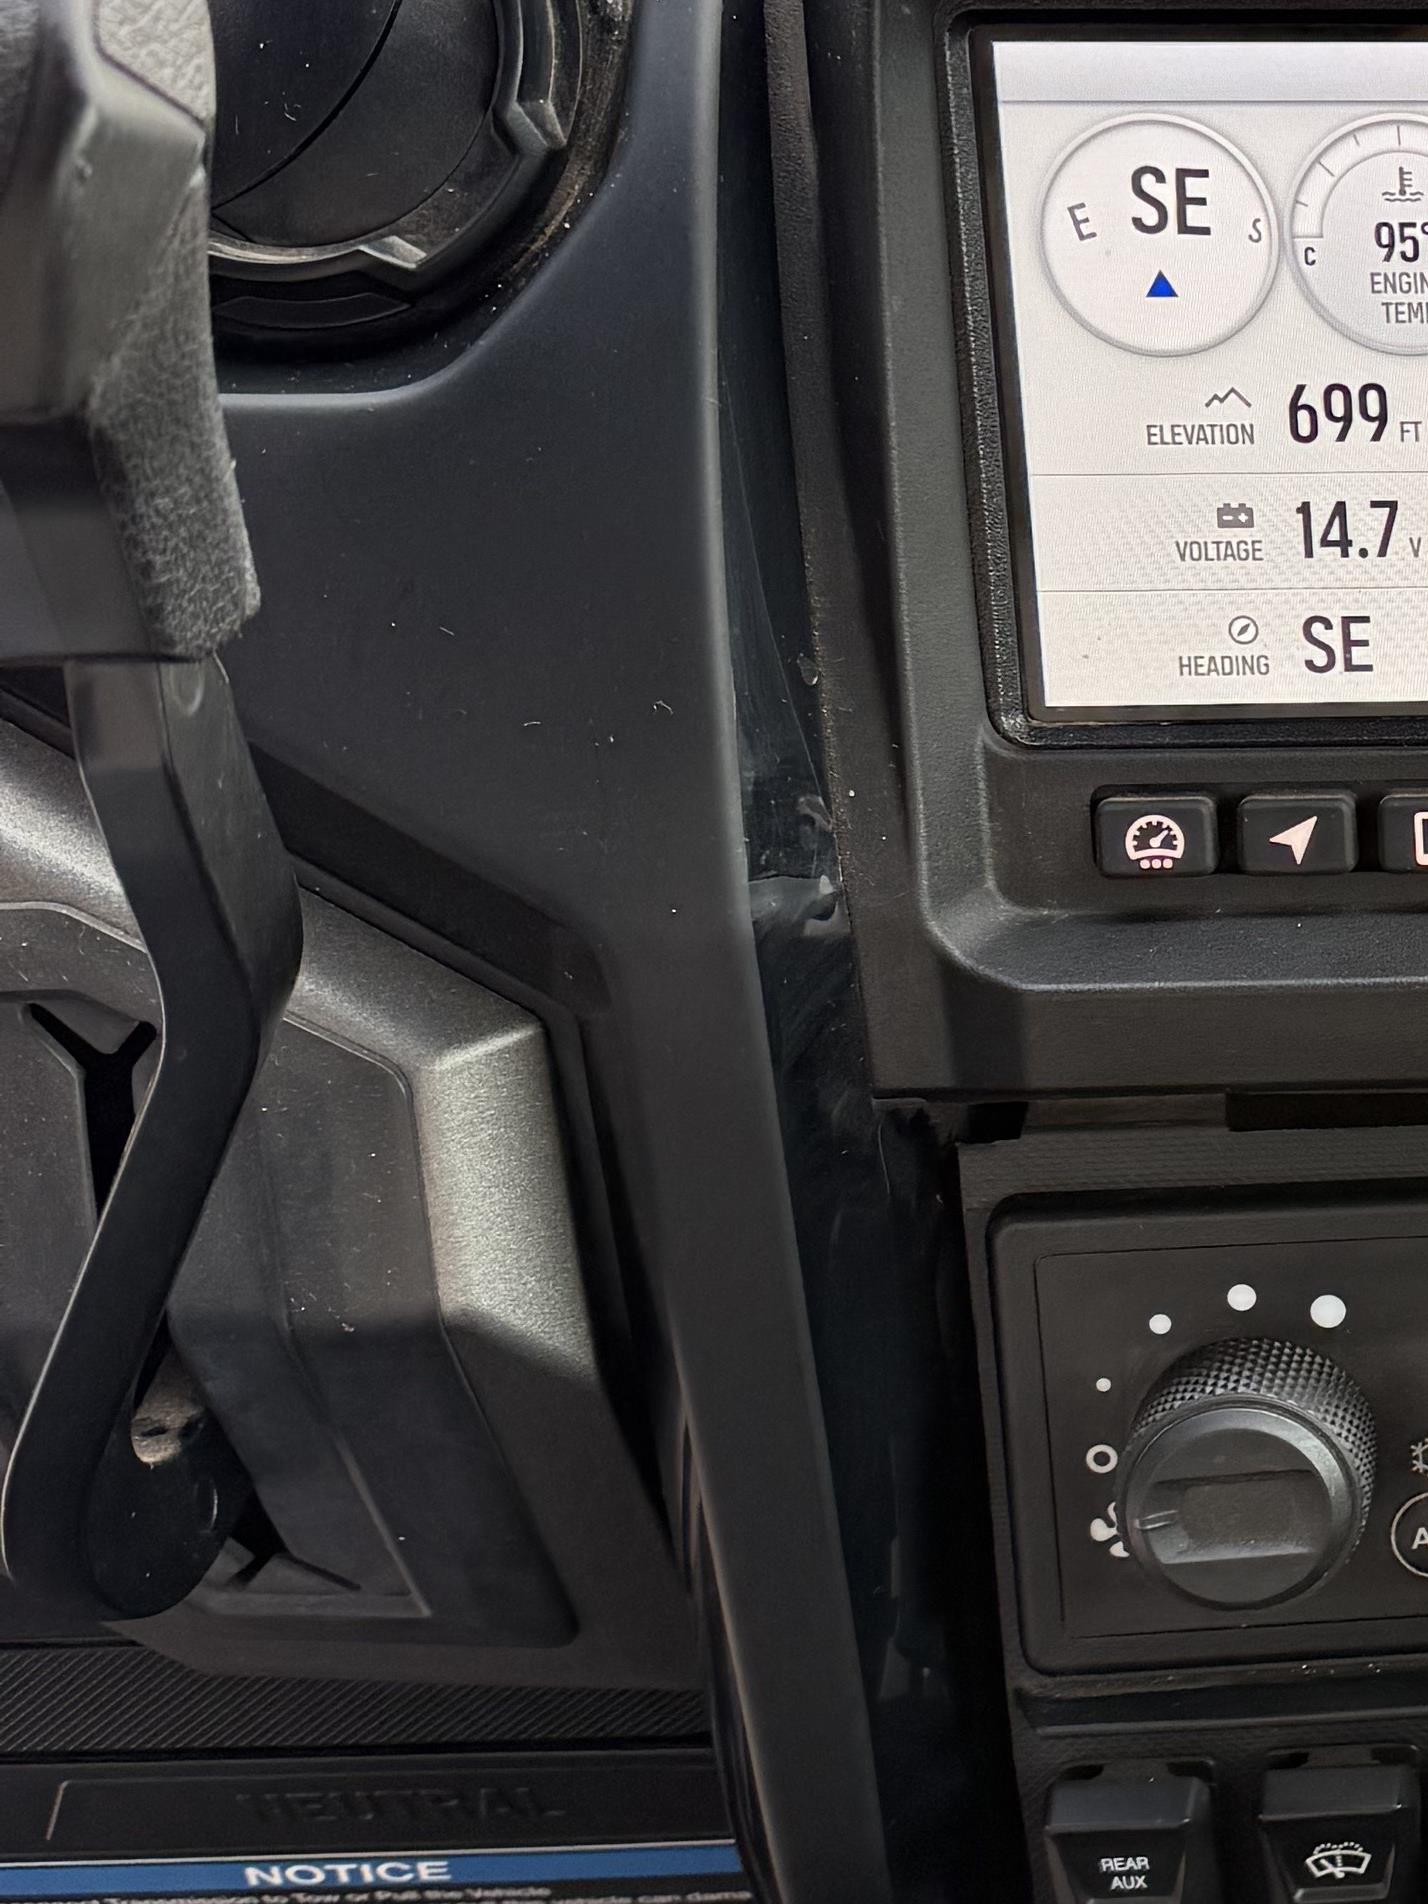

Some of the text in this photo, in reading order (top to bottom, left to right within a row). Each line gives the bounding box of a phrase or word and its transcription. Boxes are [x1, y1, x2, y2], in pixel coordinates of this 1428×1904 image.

[1131, 165, 1212, 236] SE
[1068, 202, 1098, 242] E
[1249, 215, 1265, 245] S
[1304, 246, 1317, 266] C
[1146, 382, 1423, 446] ELEVATION 699 FT
[1174, 500, 1422, 562] VOLTAGE 14.7 V
[1178, 615, 1374, 677] HEADING SE
[245, 1861, 453, 1888] NOTICE
[1100, 1856, 1151, 1872] REAR
[1110, 1875, 1148, 1891] AUX
